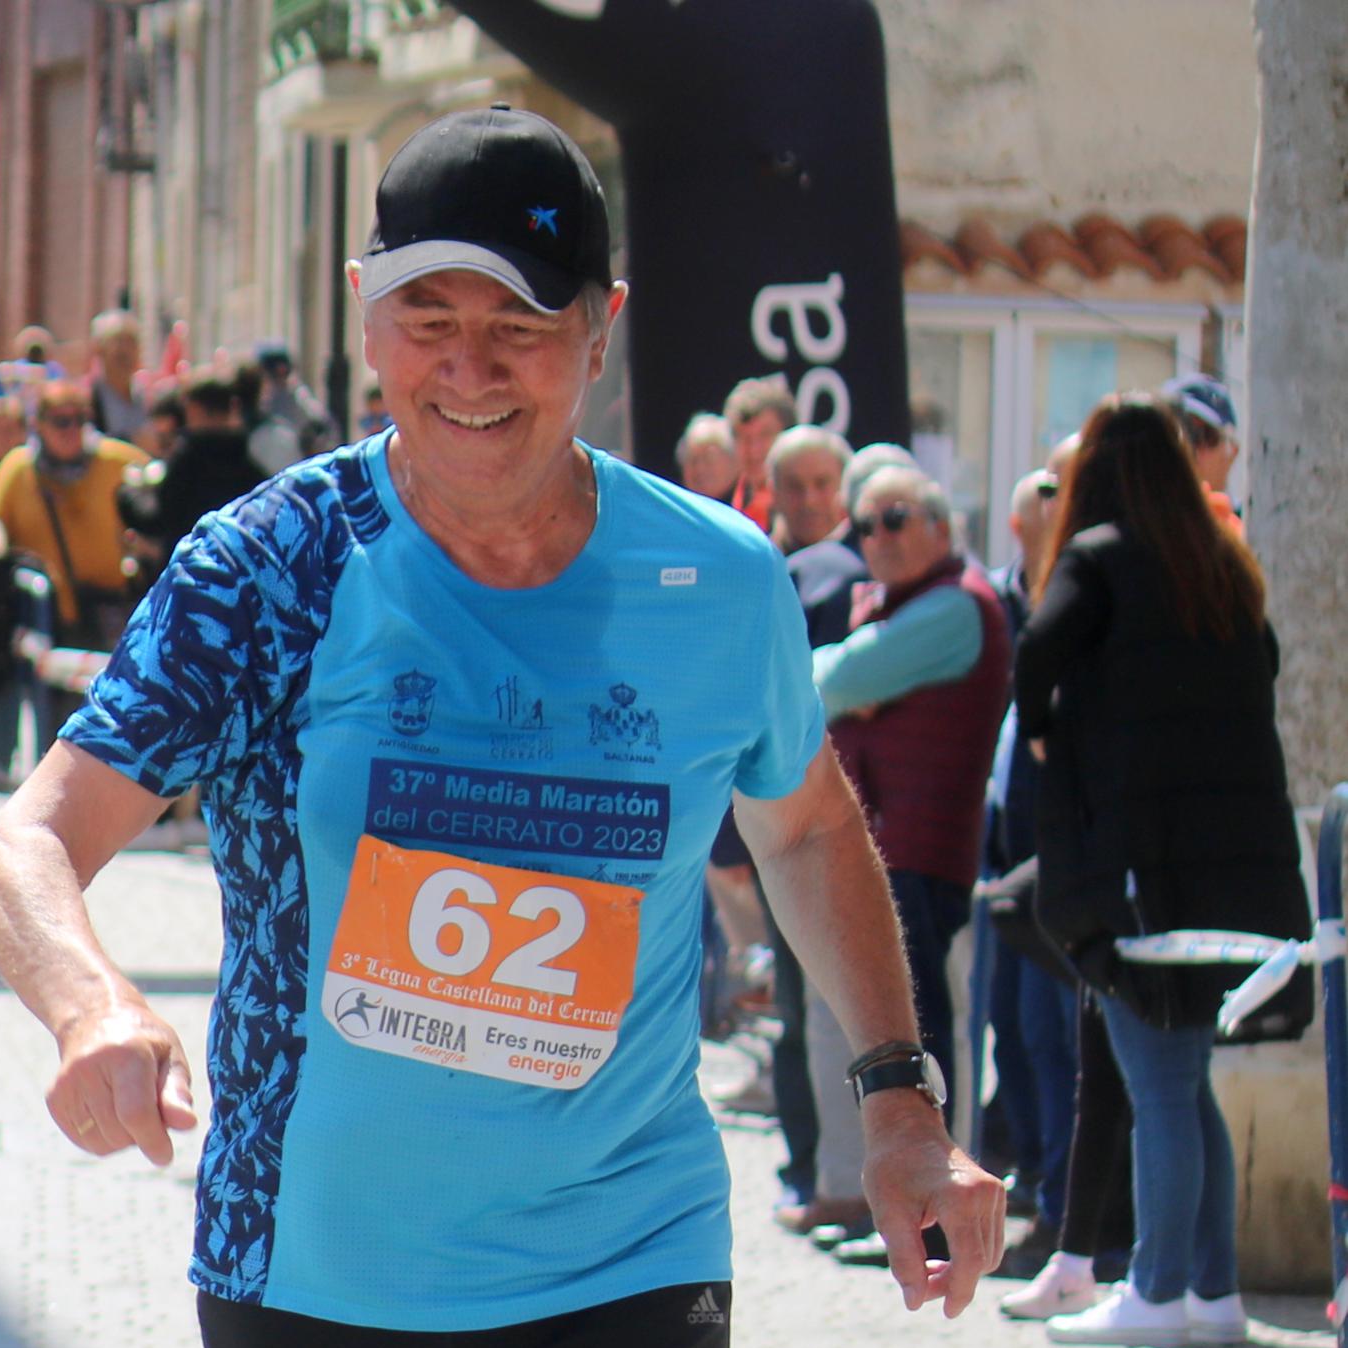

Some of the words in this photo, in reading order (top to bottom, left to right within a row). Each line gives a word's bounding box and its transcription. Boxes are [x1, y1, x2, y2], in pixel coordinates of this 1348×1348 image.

[444, 774, 531, 806] Media
[539, 784, 659, 817] Maratón
[373, 804, 417, 831] del
[426, 809, 583, 848] CERRATO
[593, 825, 663, 853] 2023
[407, 867, 586, 996] 62
[365, 956, 422, 990] Legua
[427, 976, 522, 1010] Castellana
[528, 997, 554, 1016] del
[559, 1001, 618, 1025] Cerrato
[378, 1006, 467, 1052] INTEGRA
[486, 1026, 527, 1049] Eres
[533, 1038, 602, 1060] nuestra
[508, 1053, 583, 1081] energía
